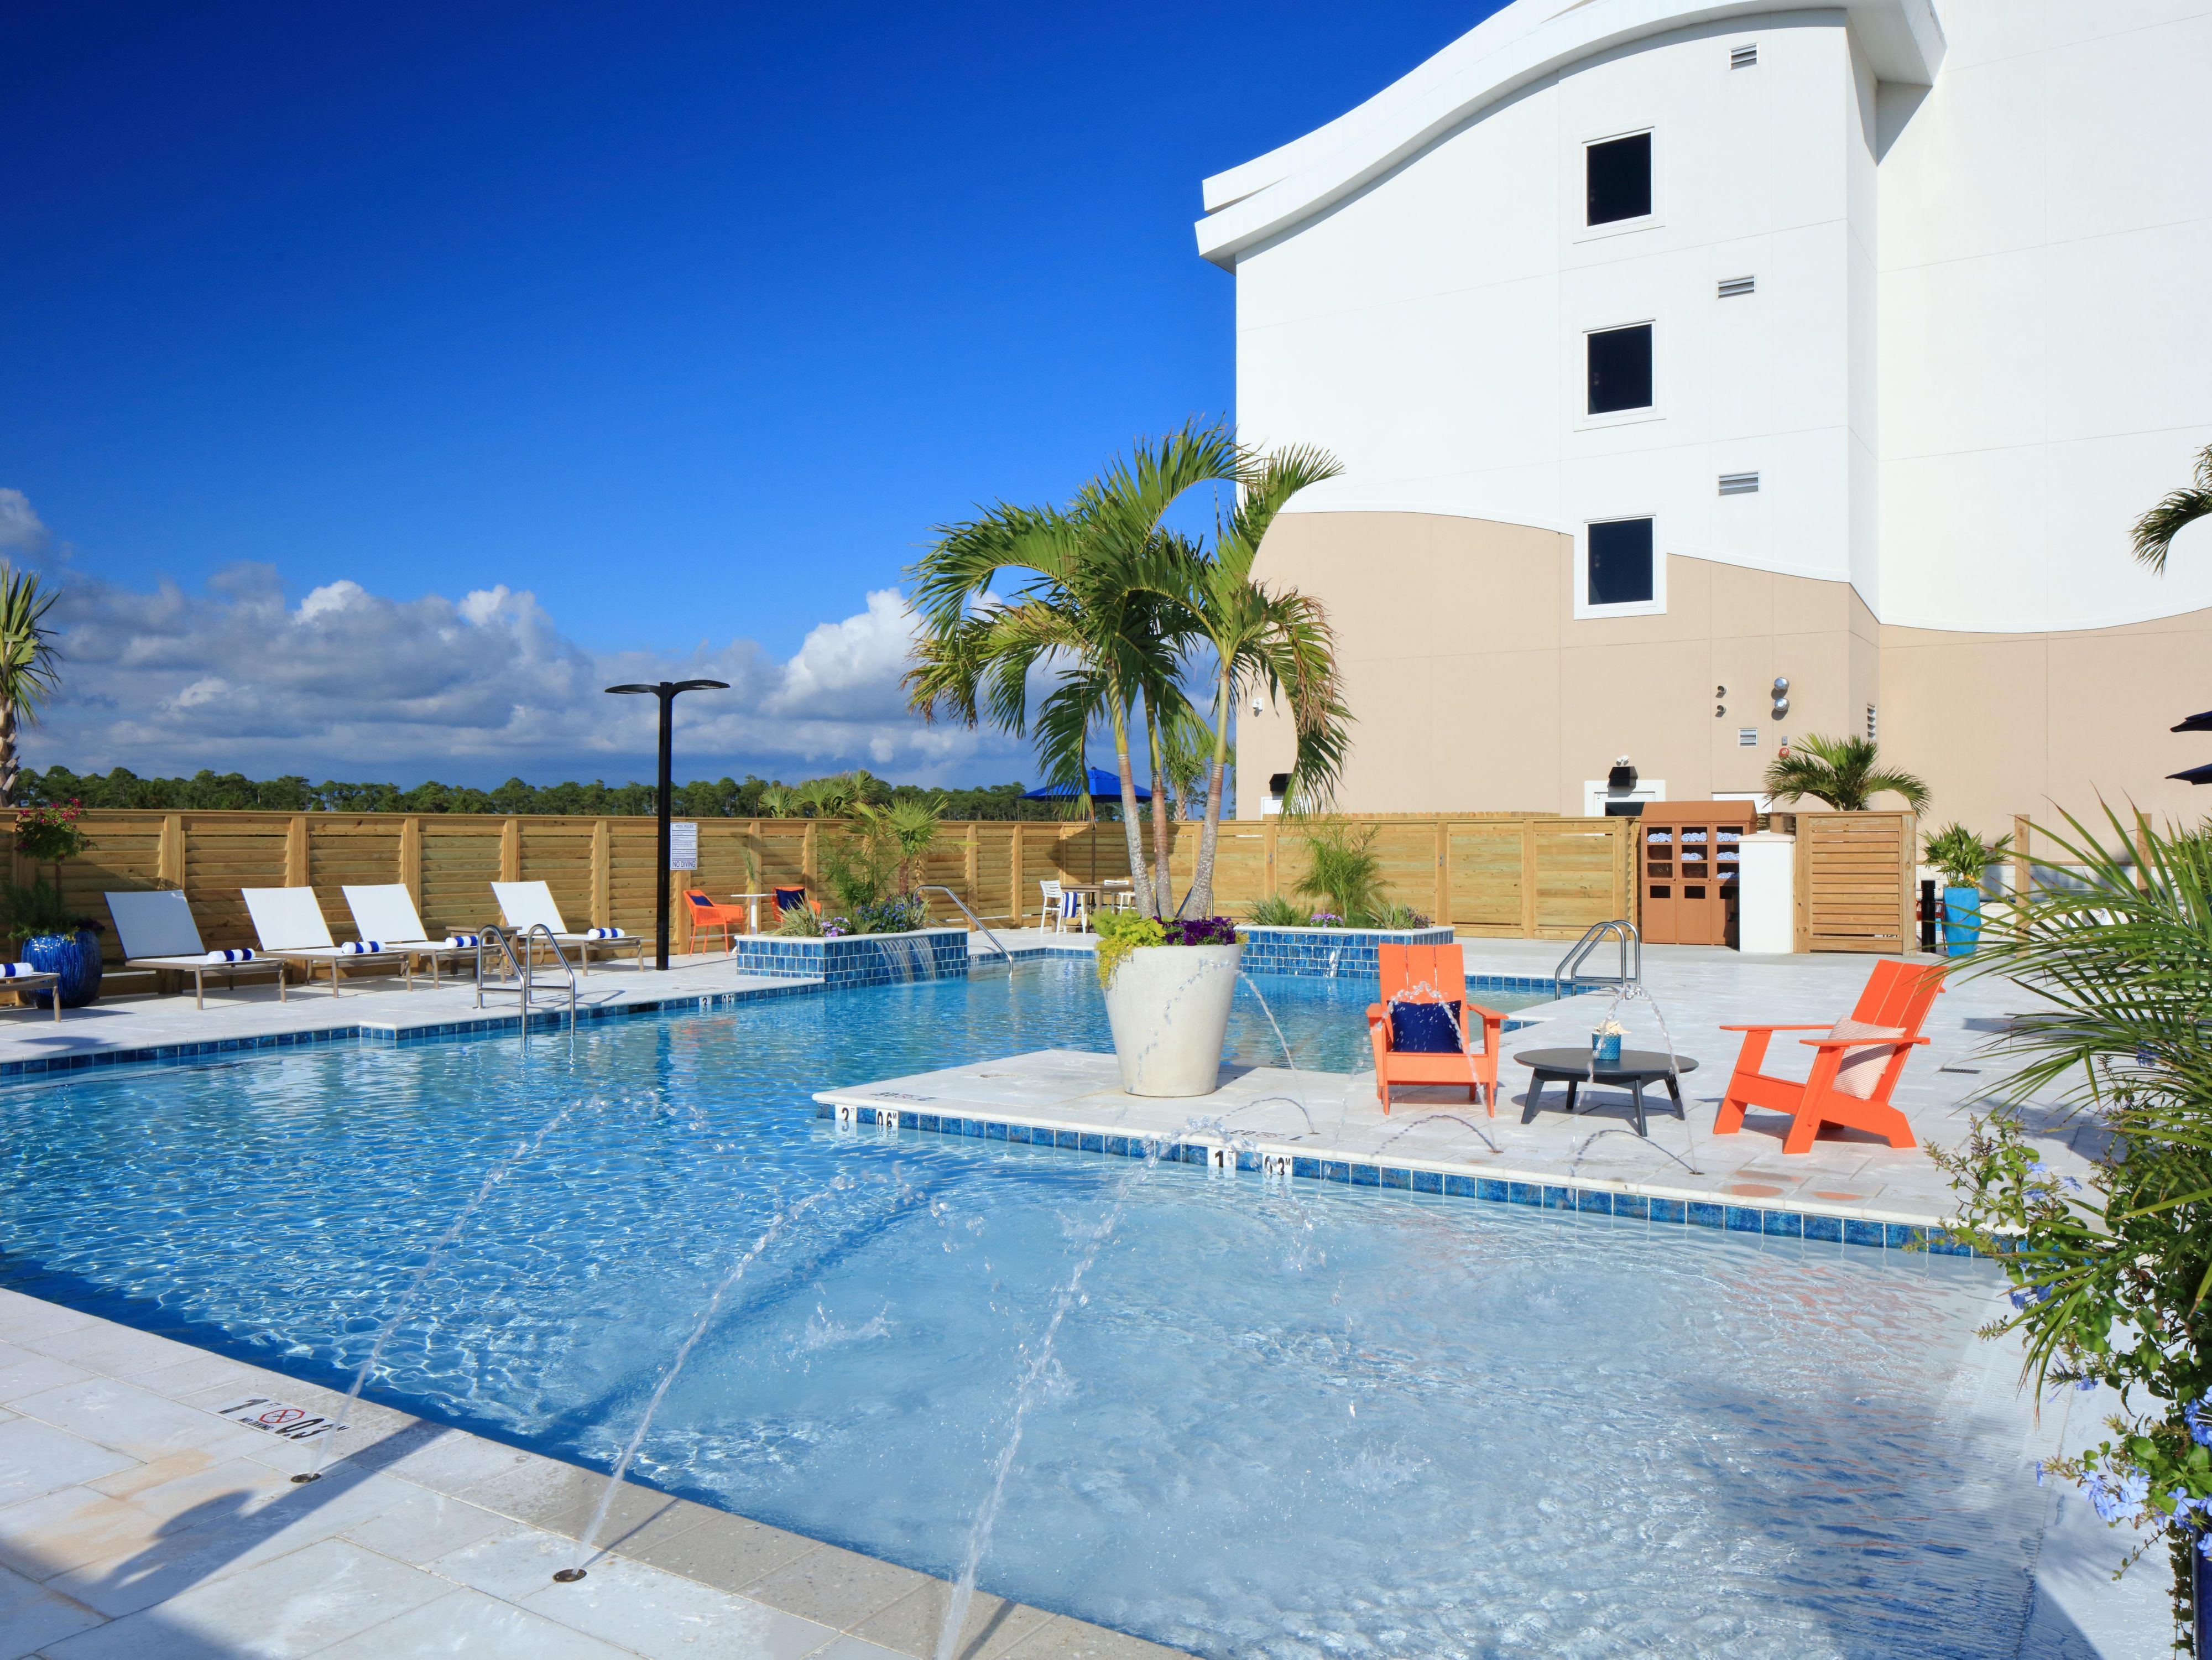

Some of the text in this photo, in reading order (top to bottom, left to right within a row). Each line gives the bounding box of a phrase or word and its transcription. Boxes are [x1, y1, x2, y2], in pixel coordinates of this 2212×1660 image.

[842, 1107, 849, 1121] 2
[1215, 1151, 1224, 1168] 1
[218, 1399, 270, 1414] 1
[248, 1420, 274, 1430] DIVING
